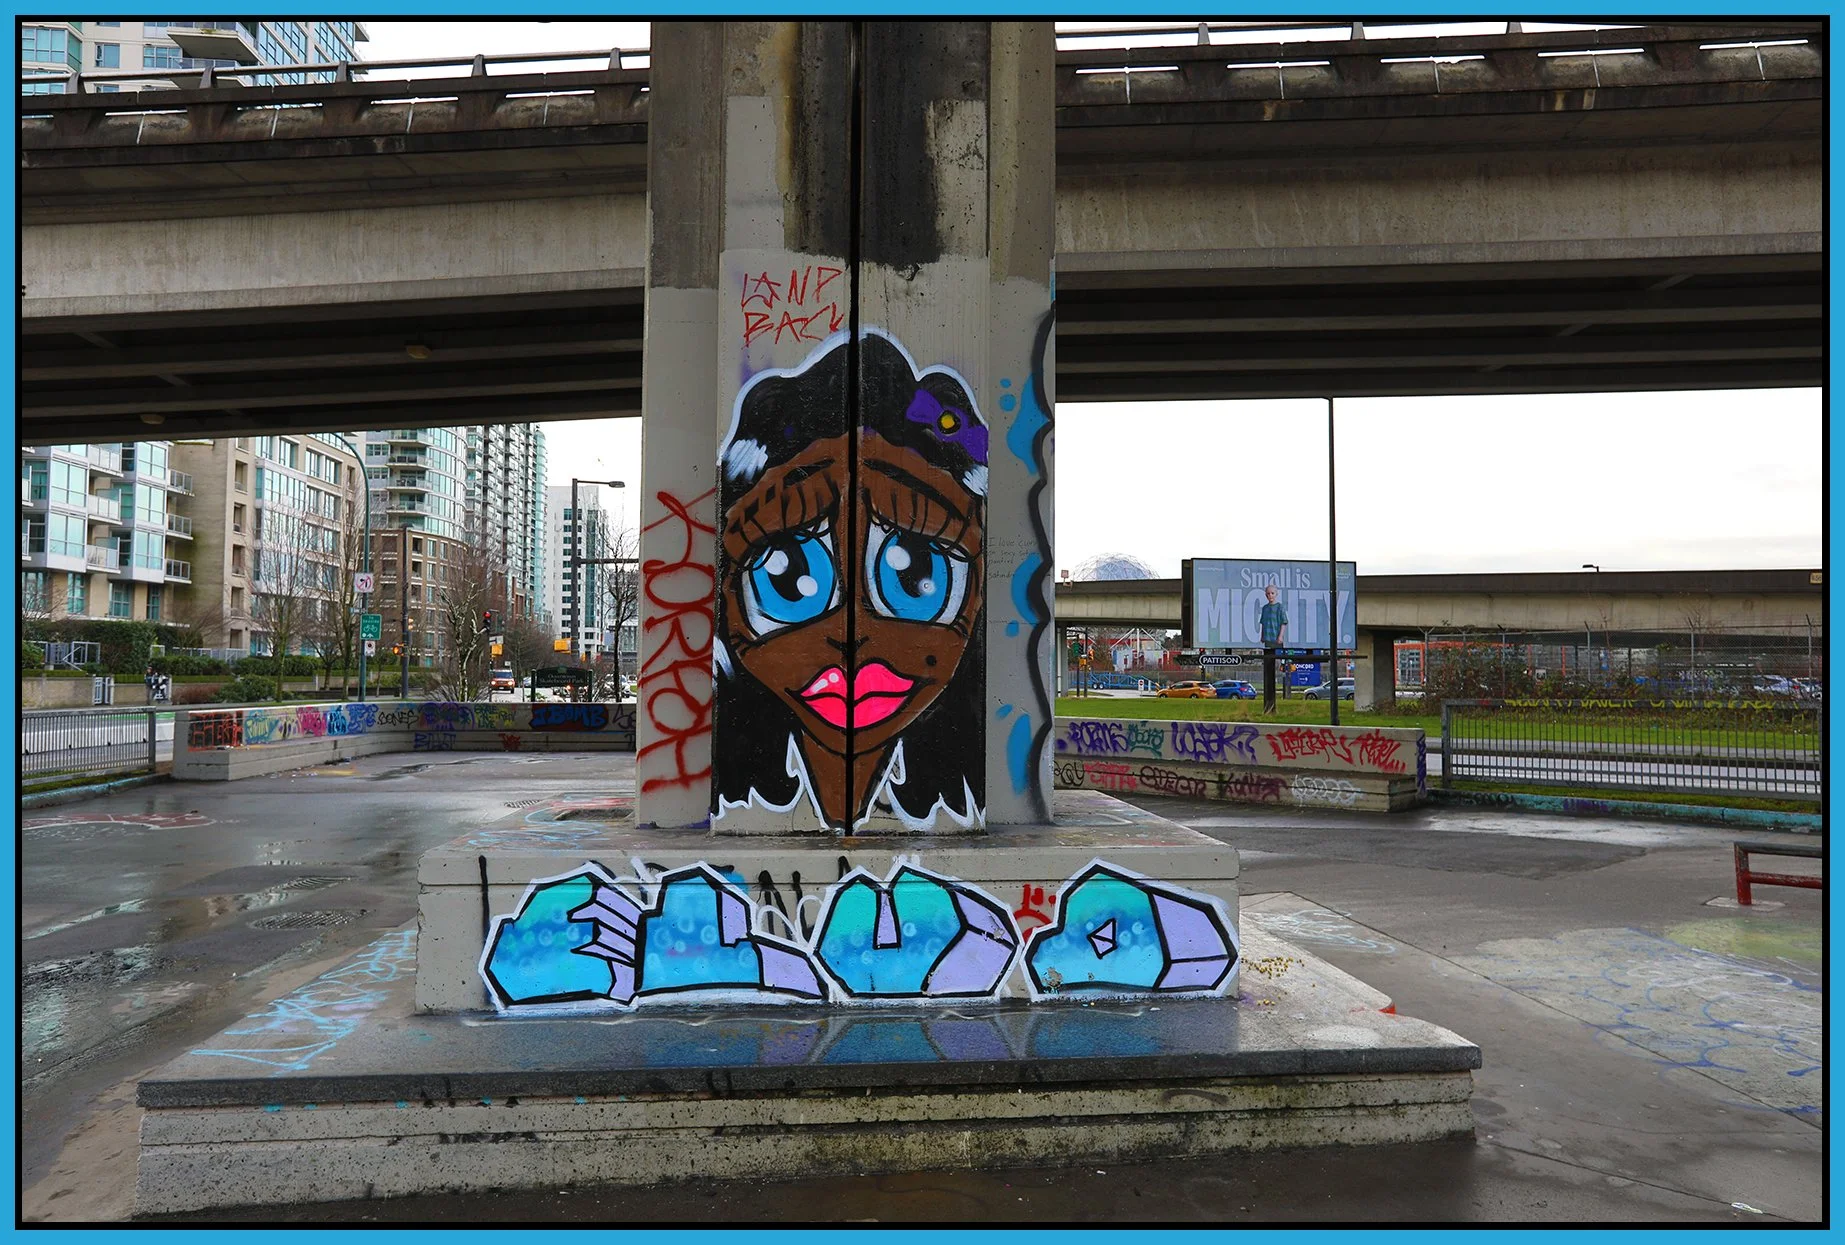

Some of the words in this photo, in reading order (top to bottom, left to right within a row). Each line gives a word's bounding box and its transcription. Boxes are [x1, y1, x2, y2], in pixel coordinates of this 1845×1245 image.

[1240, 567, 1291, 589] Small
[1296, 567, 1311, 589] is
[1202, 656, 1239, 664] PATTISON
